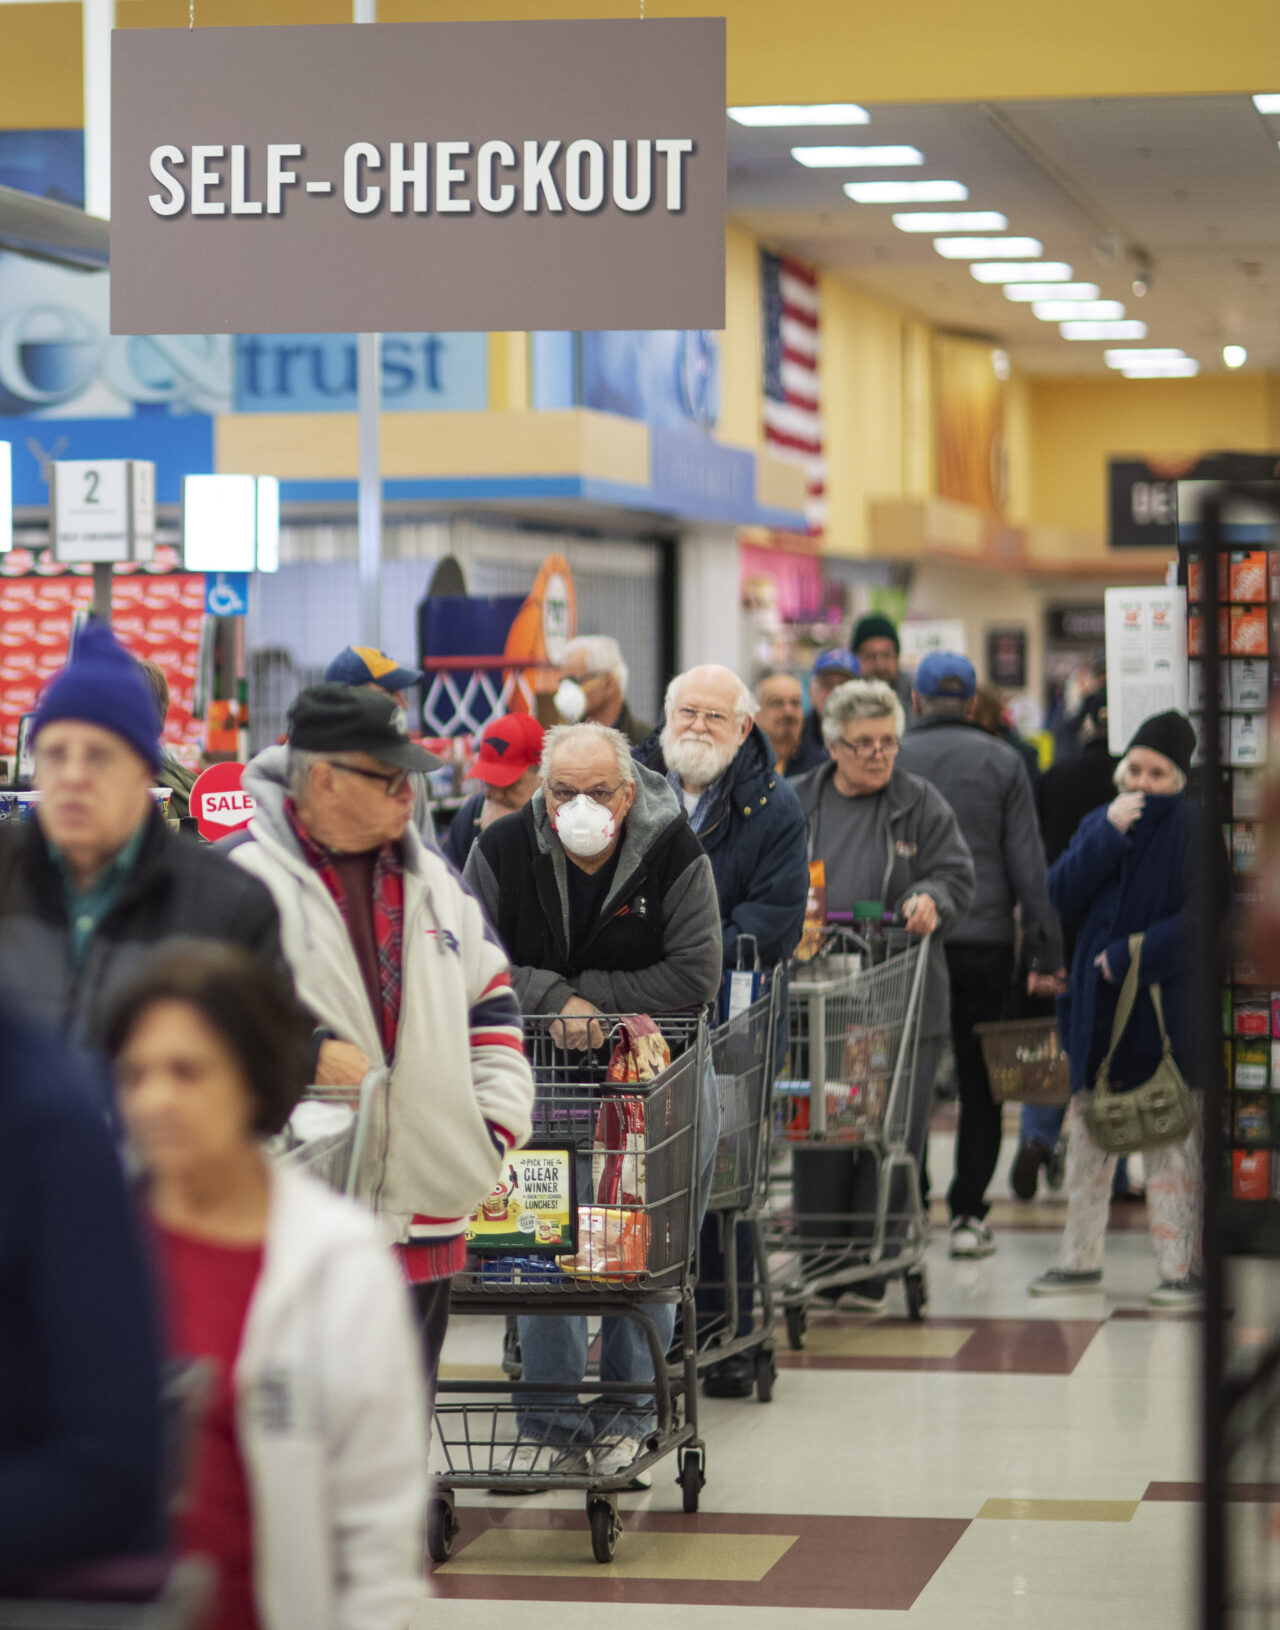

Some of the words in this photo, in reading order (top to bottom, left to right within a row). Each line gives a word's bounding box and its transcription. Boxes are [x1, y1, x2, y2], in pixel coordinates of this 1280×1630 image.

[147, 138, 693, 217] SELF-CHECKOUT
[237, 332, 446, 398] trust
[83, 469, 101, 505] 2
[205, 794, 254, 813] SALE
[526, 1158, 540, 1167] PICK
[543, 1158, 555, 1167] THE
[523, 1167, 559, 1182] CLEAR
[524, 1182, 558, 1193] WINNER
[525, 1200, 558, 1210] LUNCHES!
